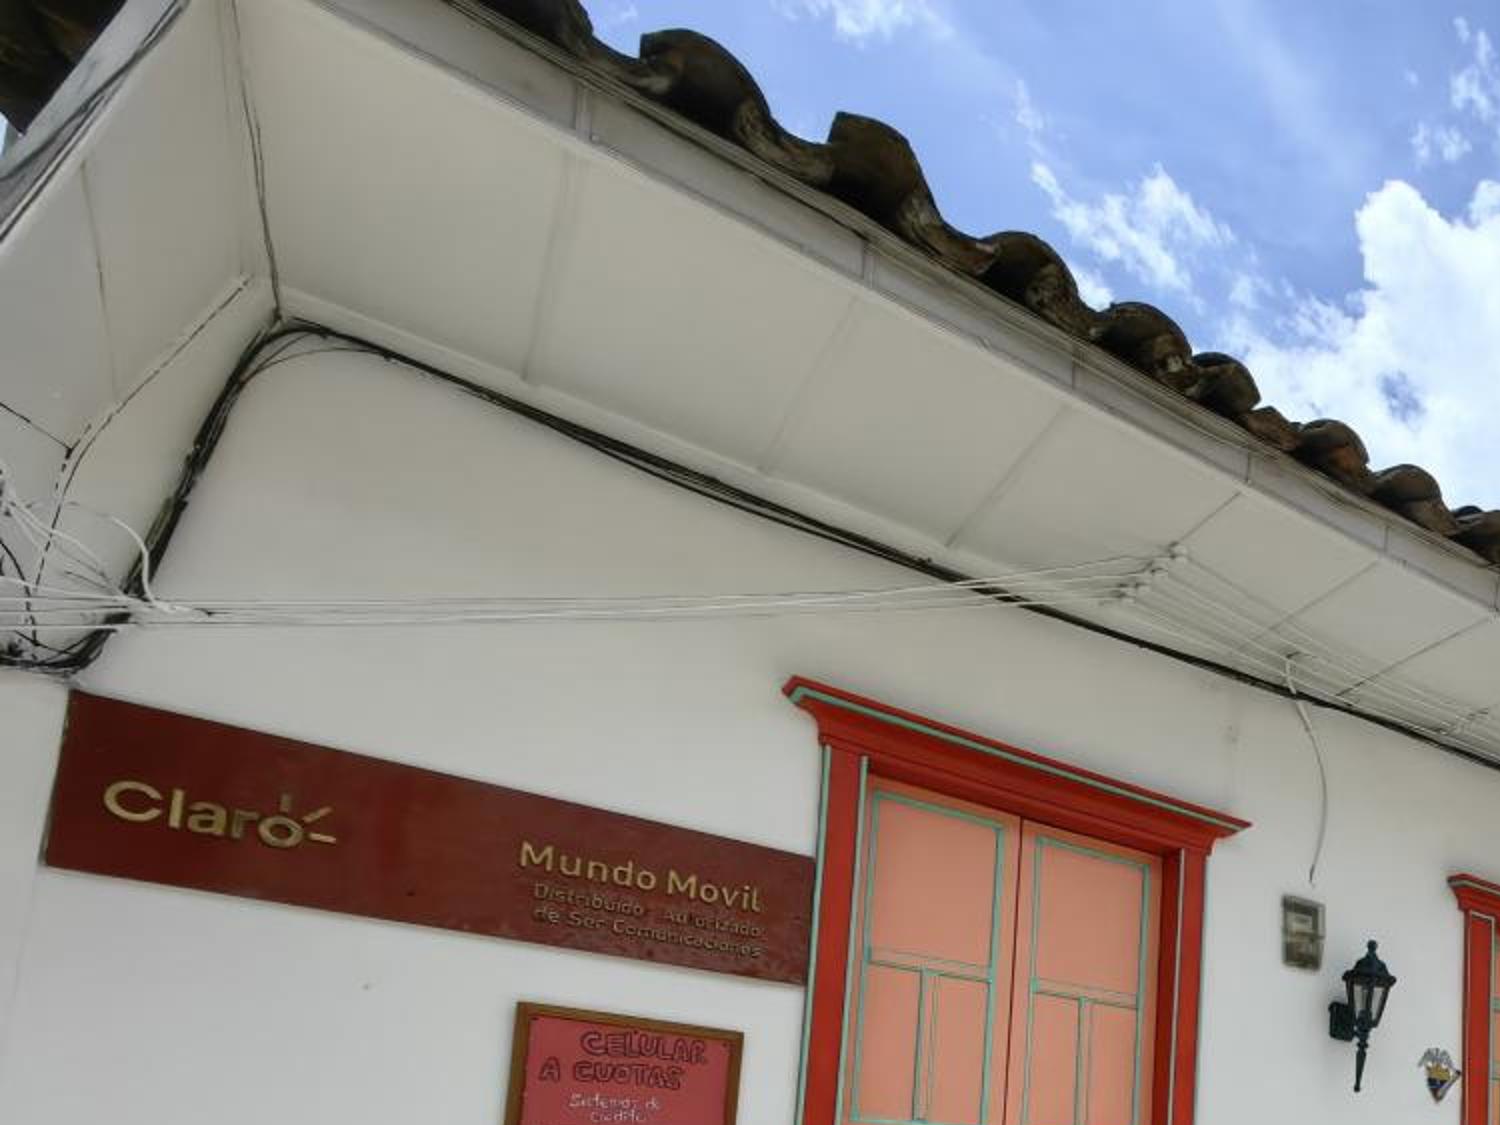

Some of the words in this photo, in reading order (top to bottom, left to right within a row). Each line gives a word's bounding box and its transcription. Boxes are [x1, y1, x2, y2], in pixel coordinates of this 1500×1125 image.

[103, 780, 306, 849] Claro
[519, 841, 658, 892] Mundo
[667, 869, 763, 914] Movil
[538, 1056, 562, 1083] A
[573, 1060, 686, 1091] CUOTAS
[580, 1030, 709, 1065] CELULAR
